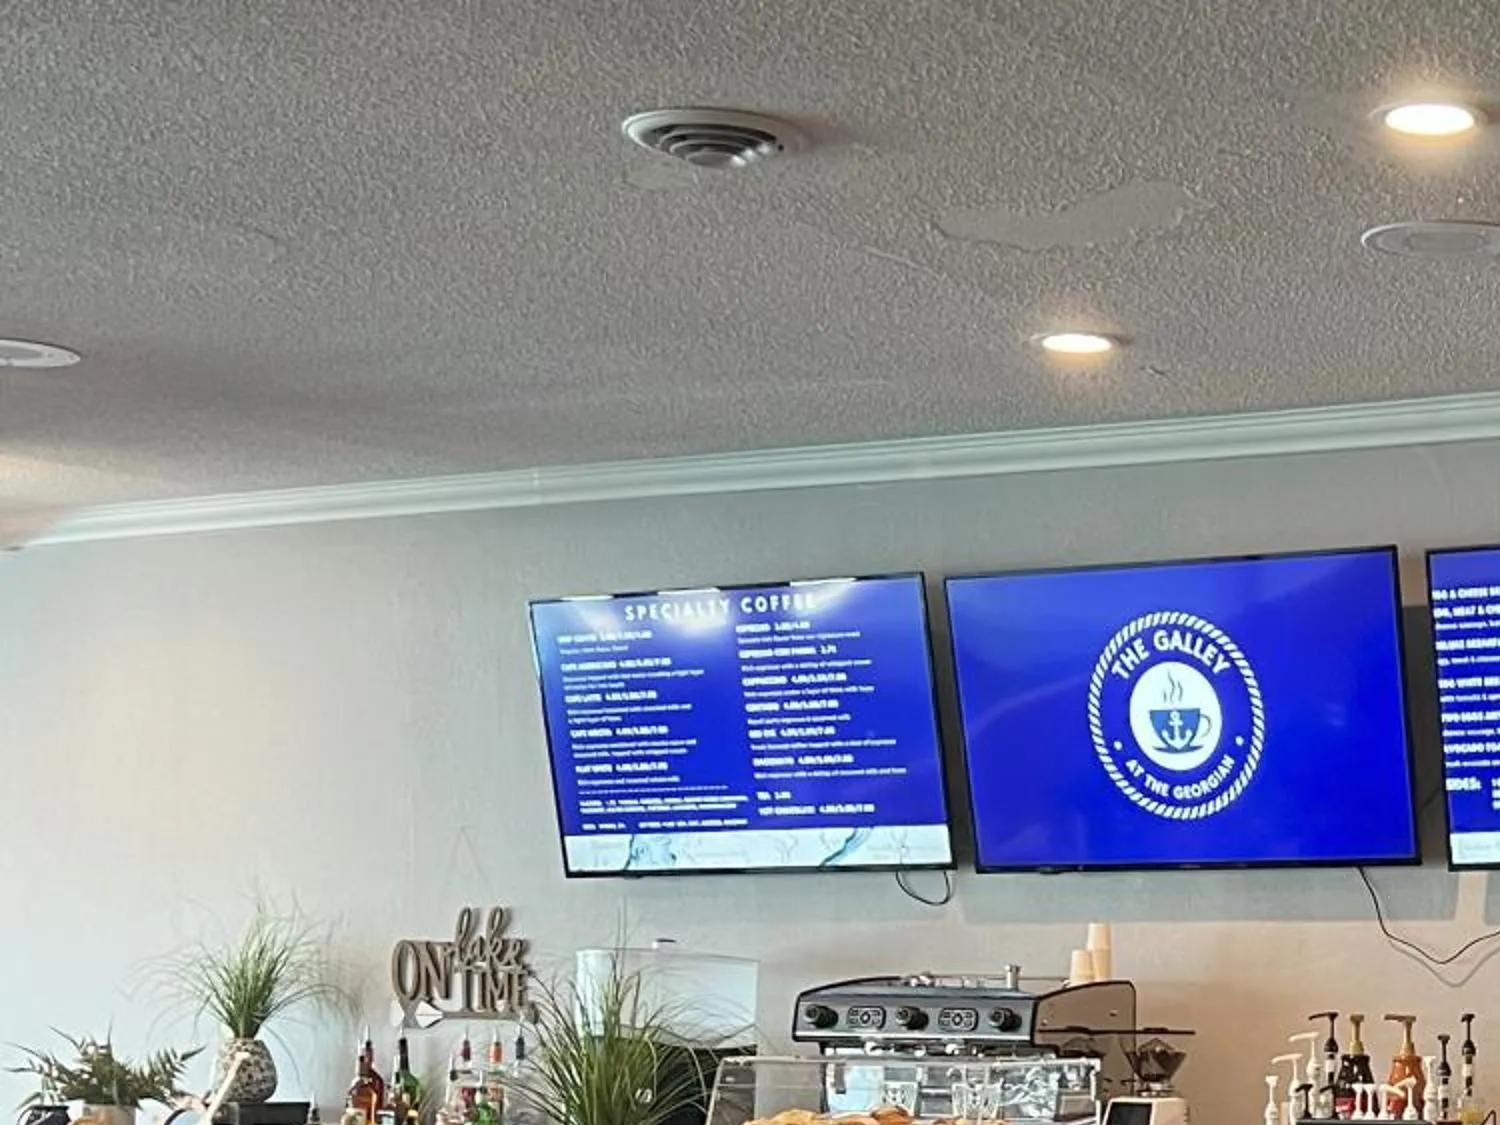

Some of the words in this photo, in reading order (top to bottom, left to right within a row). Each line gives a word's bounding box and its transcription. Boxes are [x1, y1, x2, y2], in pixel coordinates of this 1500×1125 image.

[624, 598, 729, 621] SPECIALTY
[741, 594, 815, 613] COFFEE
[1111, 638, 1150, 679] THE
[1154, 630, 1231, 674] GALLEY
[1125, 759, 1144, 778] AT
[1144, 774, 1170, 797] THE
[1173, 754, 1235, 800] GEORGIAN
[456, 906, 525, 964] lake
[391, 940, 452, 1000] ON
[453, 964, 528, 1012] TIME
